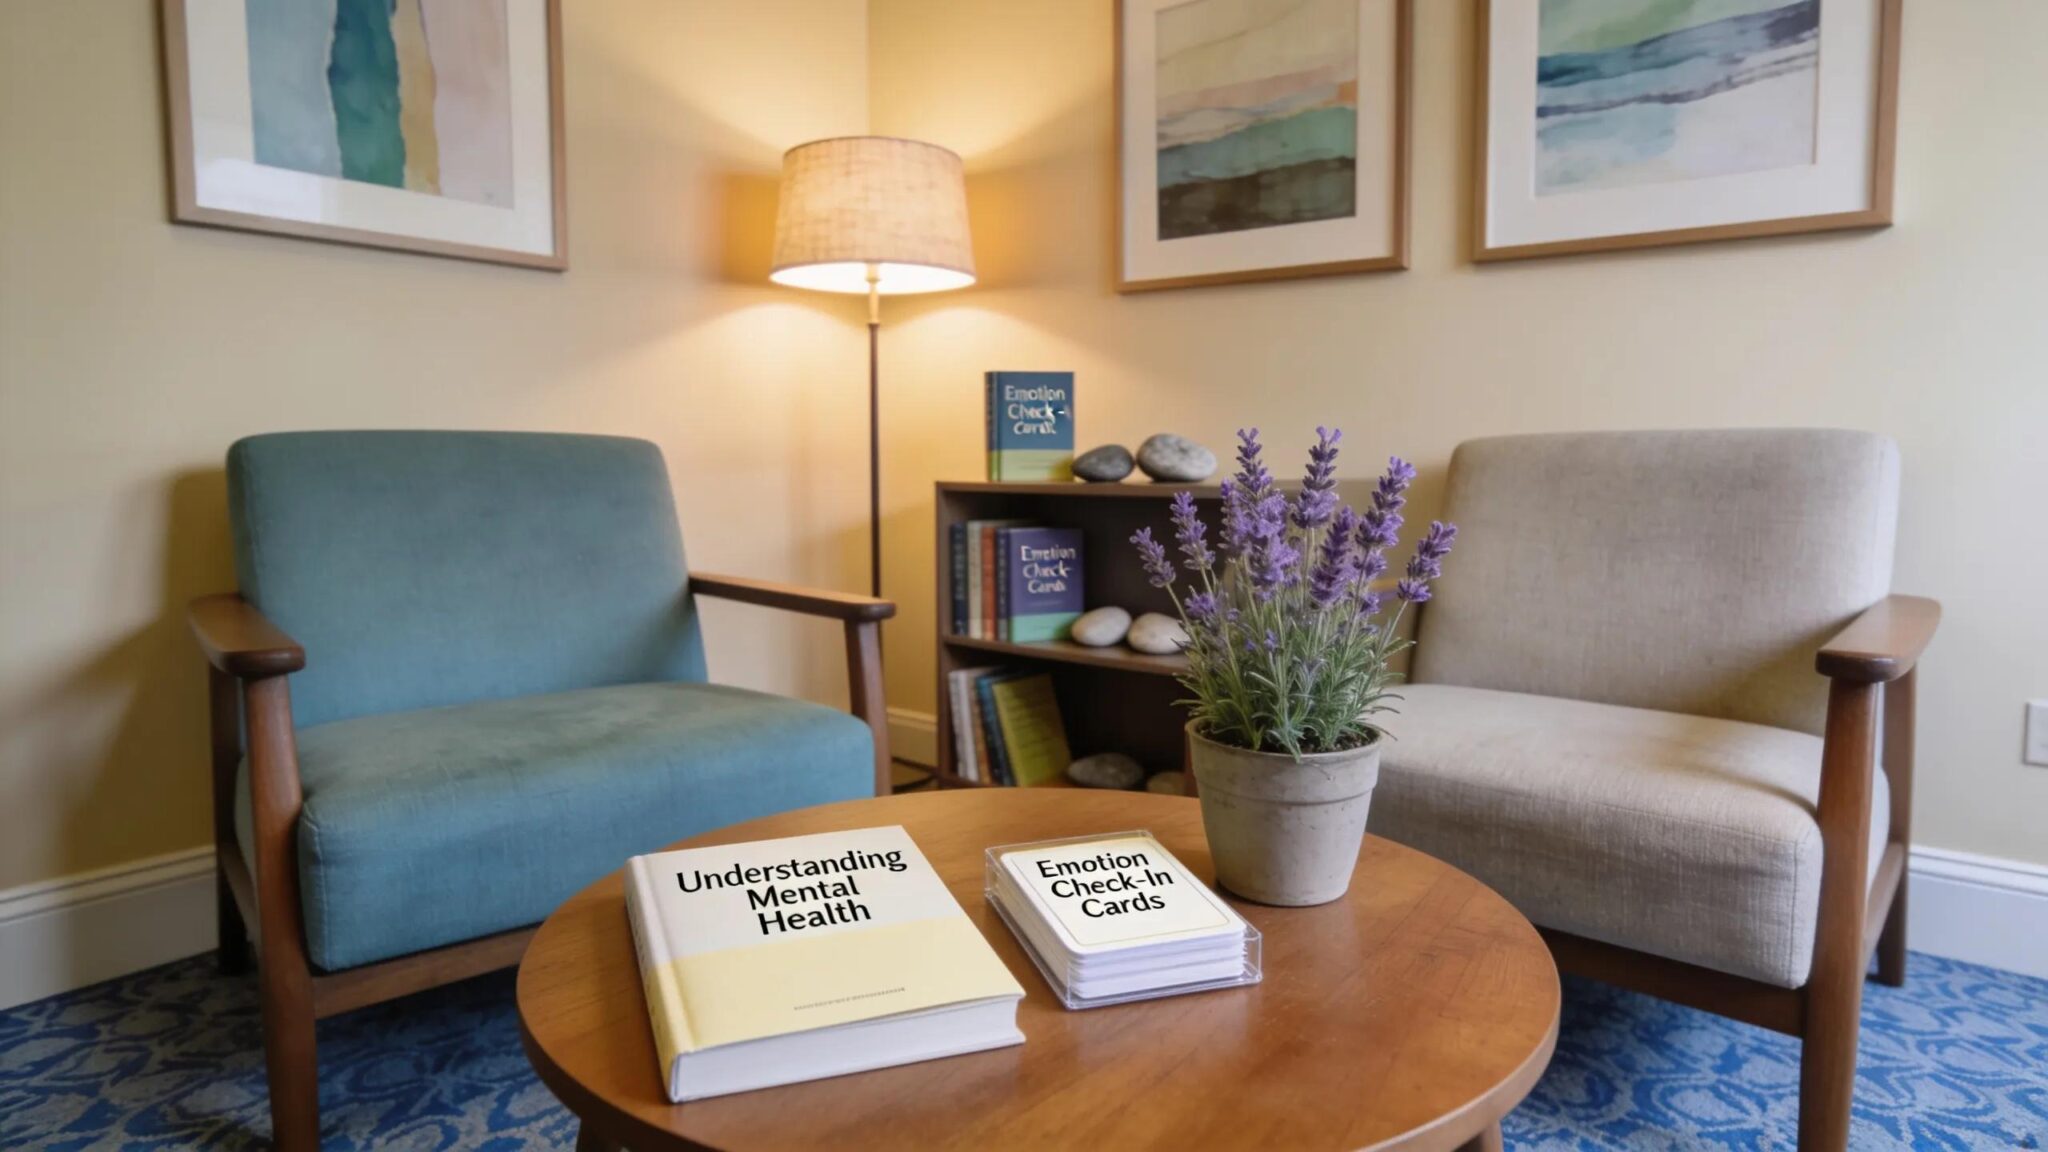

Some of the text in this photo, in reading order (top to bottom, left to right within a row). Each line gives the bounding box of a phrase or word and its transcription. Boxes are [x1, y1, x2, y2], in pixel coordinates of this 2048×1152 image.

[677, 850, 907, 893] Understanding
[1036, 853, 1149, 878] Emotion
[746, 875, 860, 910] Mental
[1051, 869, 1174, 898] Check-In
[758, 899, 871, 935] Health
[1081, 892, 1166, 918] Cards
